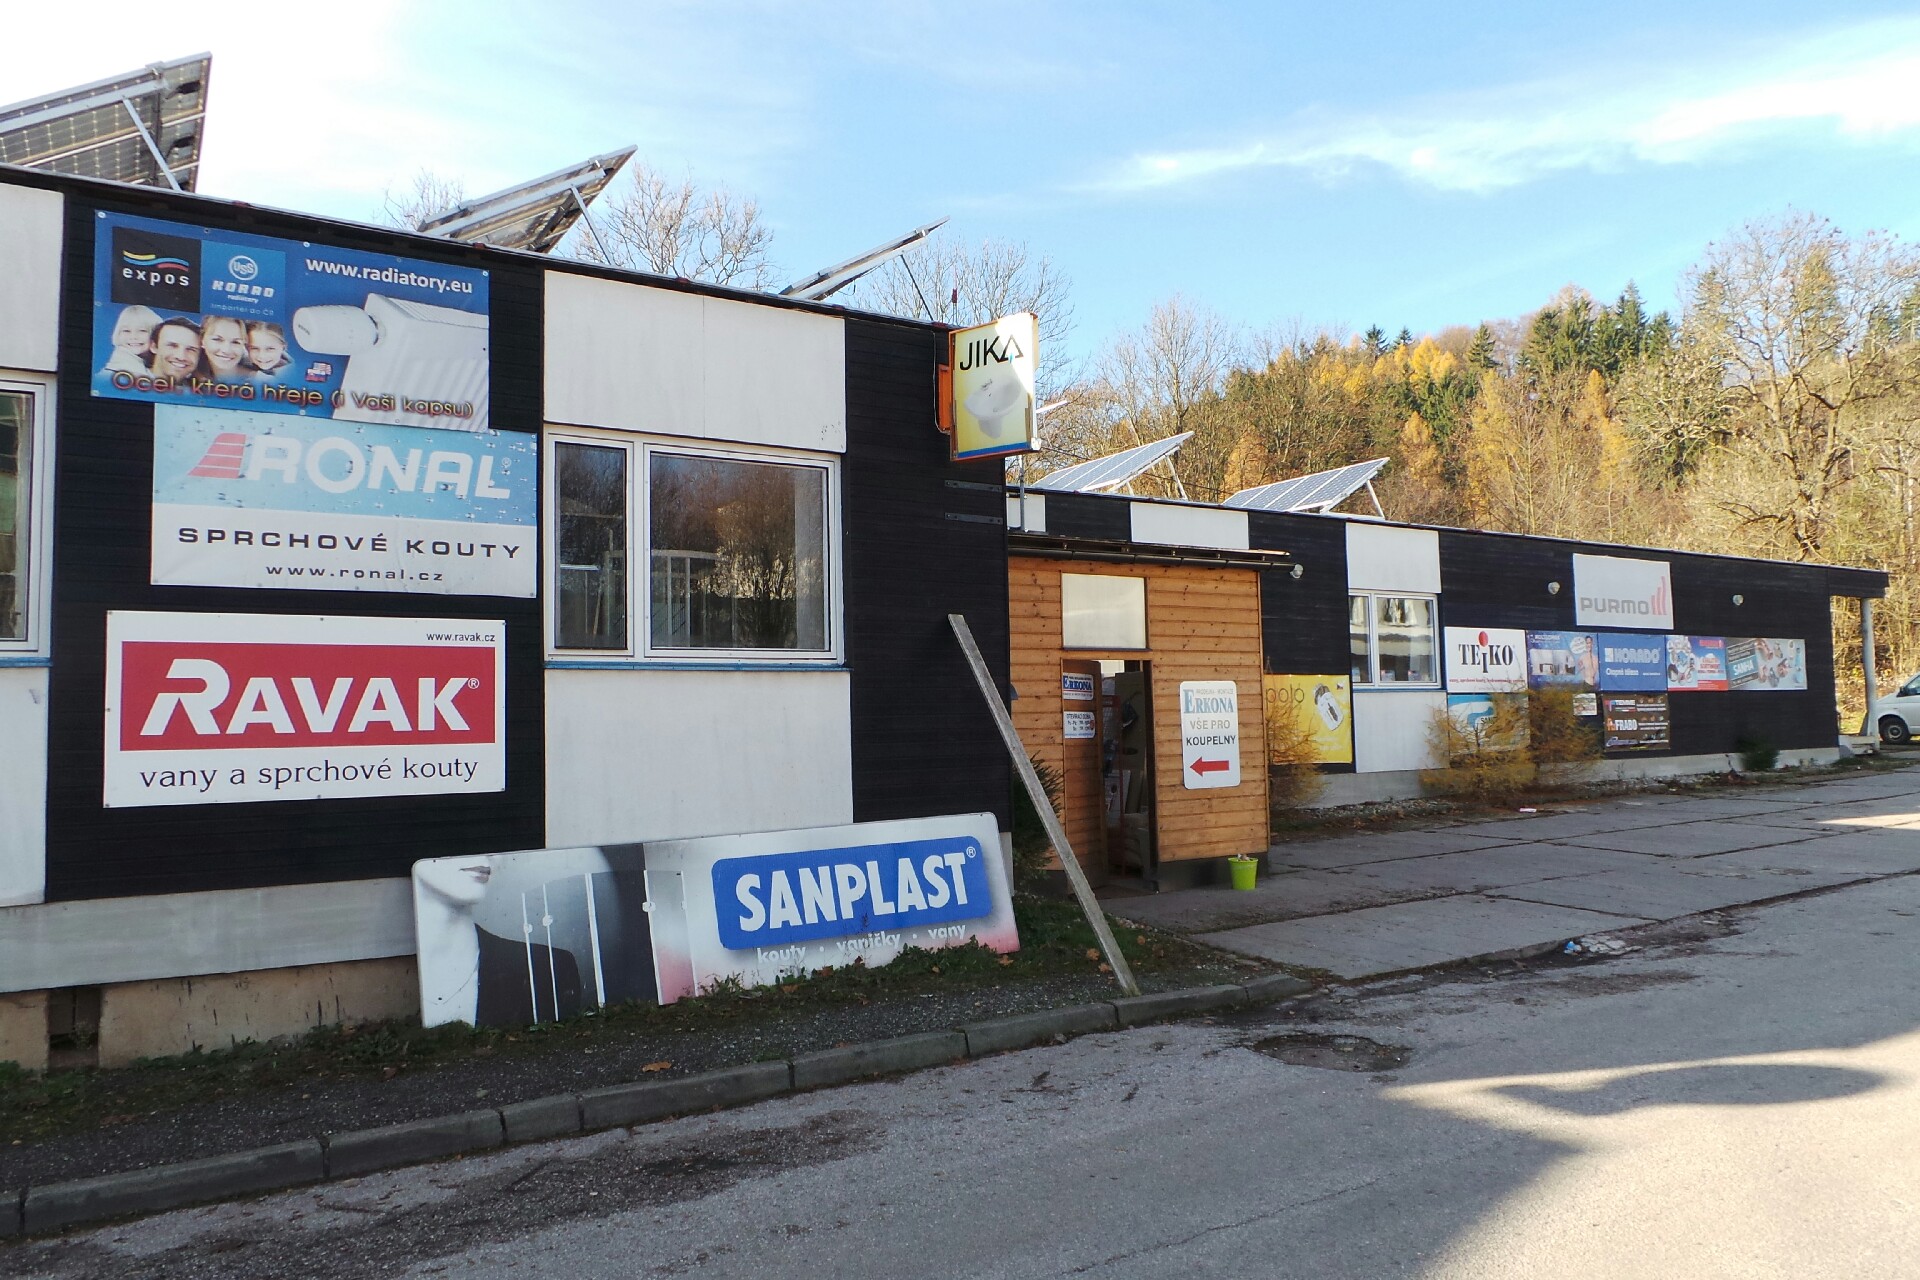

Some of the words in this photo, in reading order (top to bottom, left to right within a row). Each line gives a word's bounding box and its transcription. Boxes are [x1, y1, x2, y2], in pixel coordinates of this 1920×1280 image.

[122, 267, 190, 287] expos
[306, 258, 473, 293] www.radiatory.eu
[960, 335, 1023, 371] JIKA
[112, 371, 183, 395] Ocel,
[191, 377, 255, 399] která
[263, 383, 323, 406] hřeje
[331, 389, 345, 409] (i
[352, 392, 396, 411] Vaši
[402, 396, 473, 419] kapsu)
[247, 434, 510, 499] RONAL
[178, 527, 388, 552] SPRCHOVÉ
[406, 539, 521, 559] KOUTY
[266, 565, 443, 581] www.ronal.cz
[1580, 597, 1649, 615] PURMO
[426, 631, 496, 643] www.ravak.cz
[1459, 637, 1513, 673] TEIKO
[139, 658, 471, 736] RAVAK
[1183, 689, 1234, 714] ERKONA
[1190, 717, 1208, 729] VŠE
[1211, 719, 1231, 729] PRO
[1186, 735, 1236, 746] KOUPELNY
[139, 768, 218, 793] vany
[229, 769, 246, 784] a
[259, 757, 392, 790] sprchové
[403, 757, 479, 781] kouty
[735, 852, 968, 932] SANPLAST
[928, 925, 967, 940] vany
